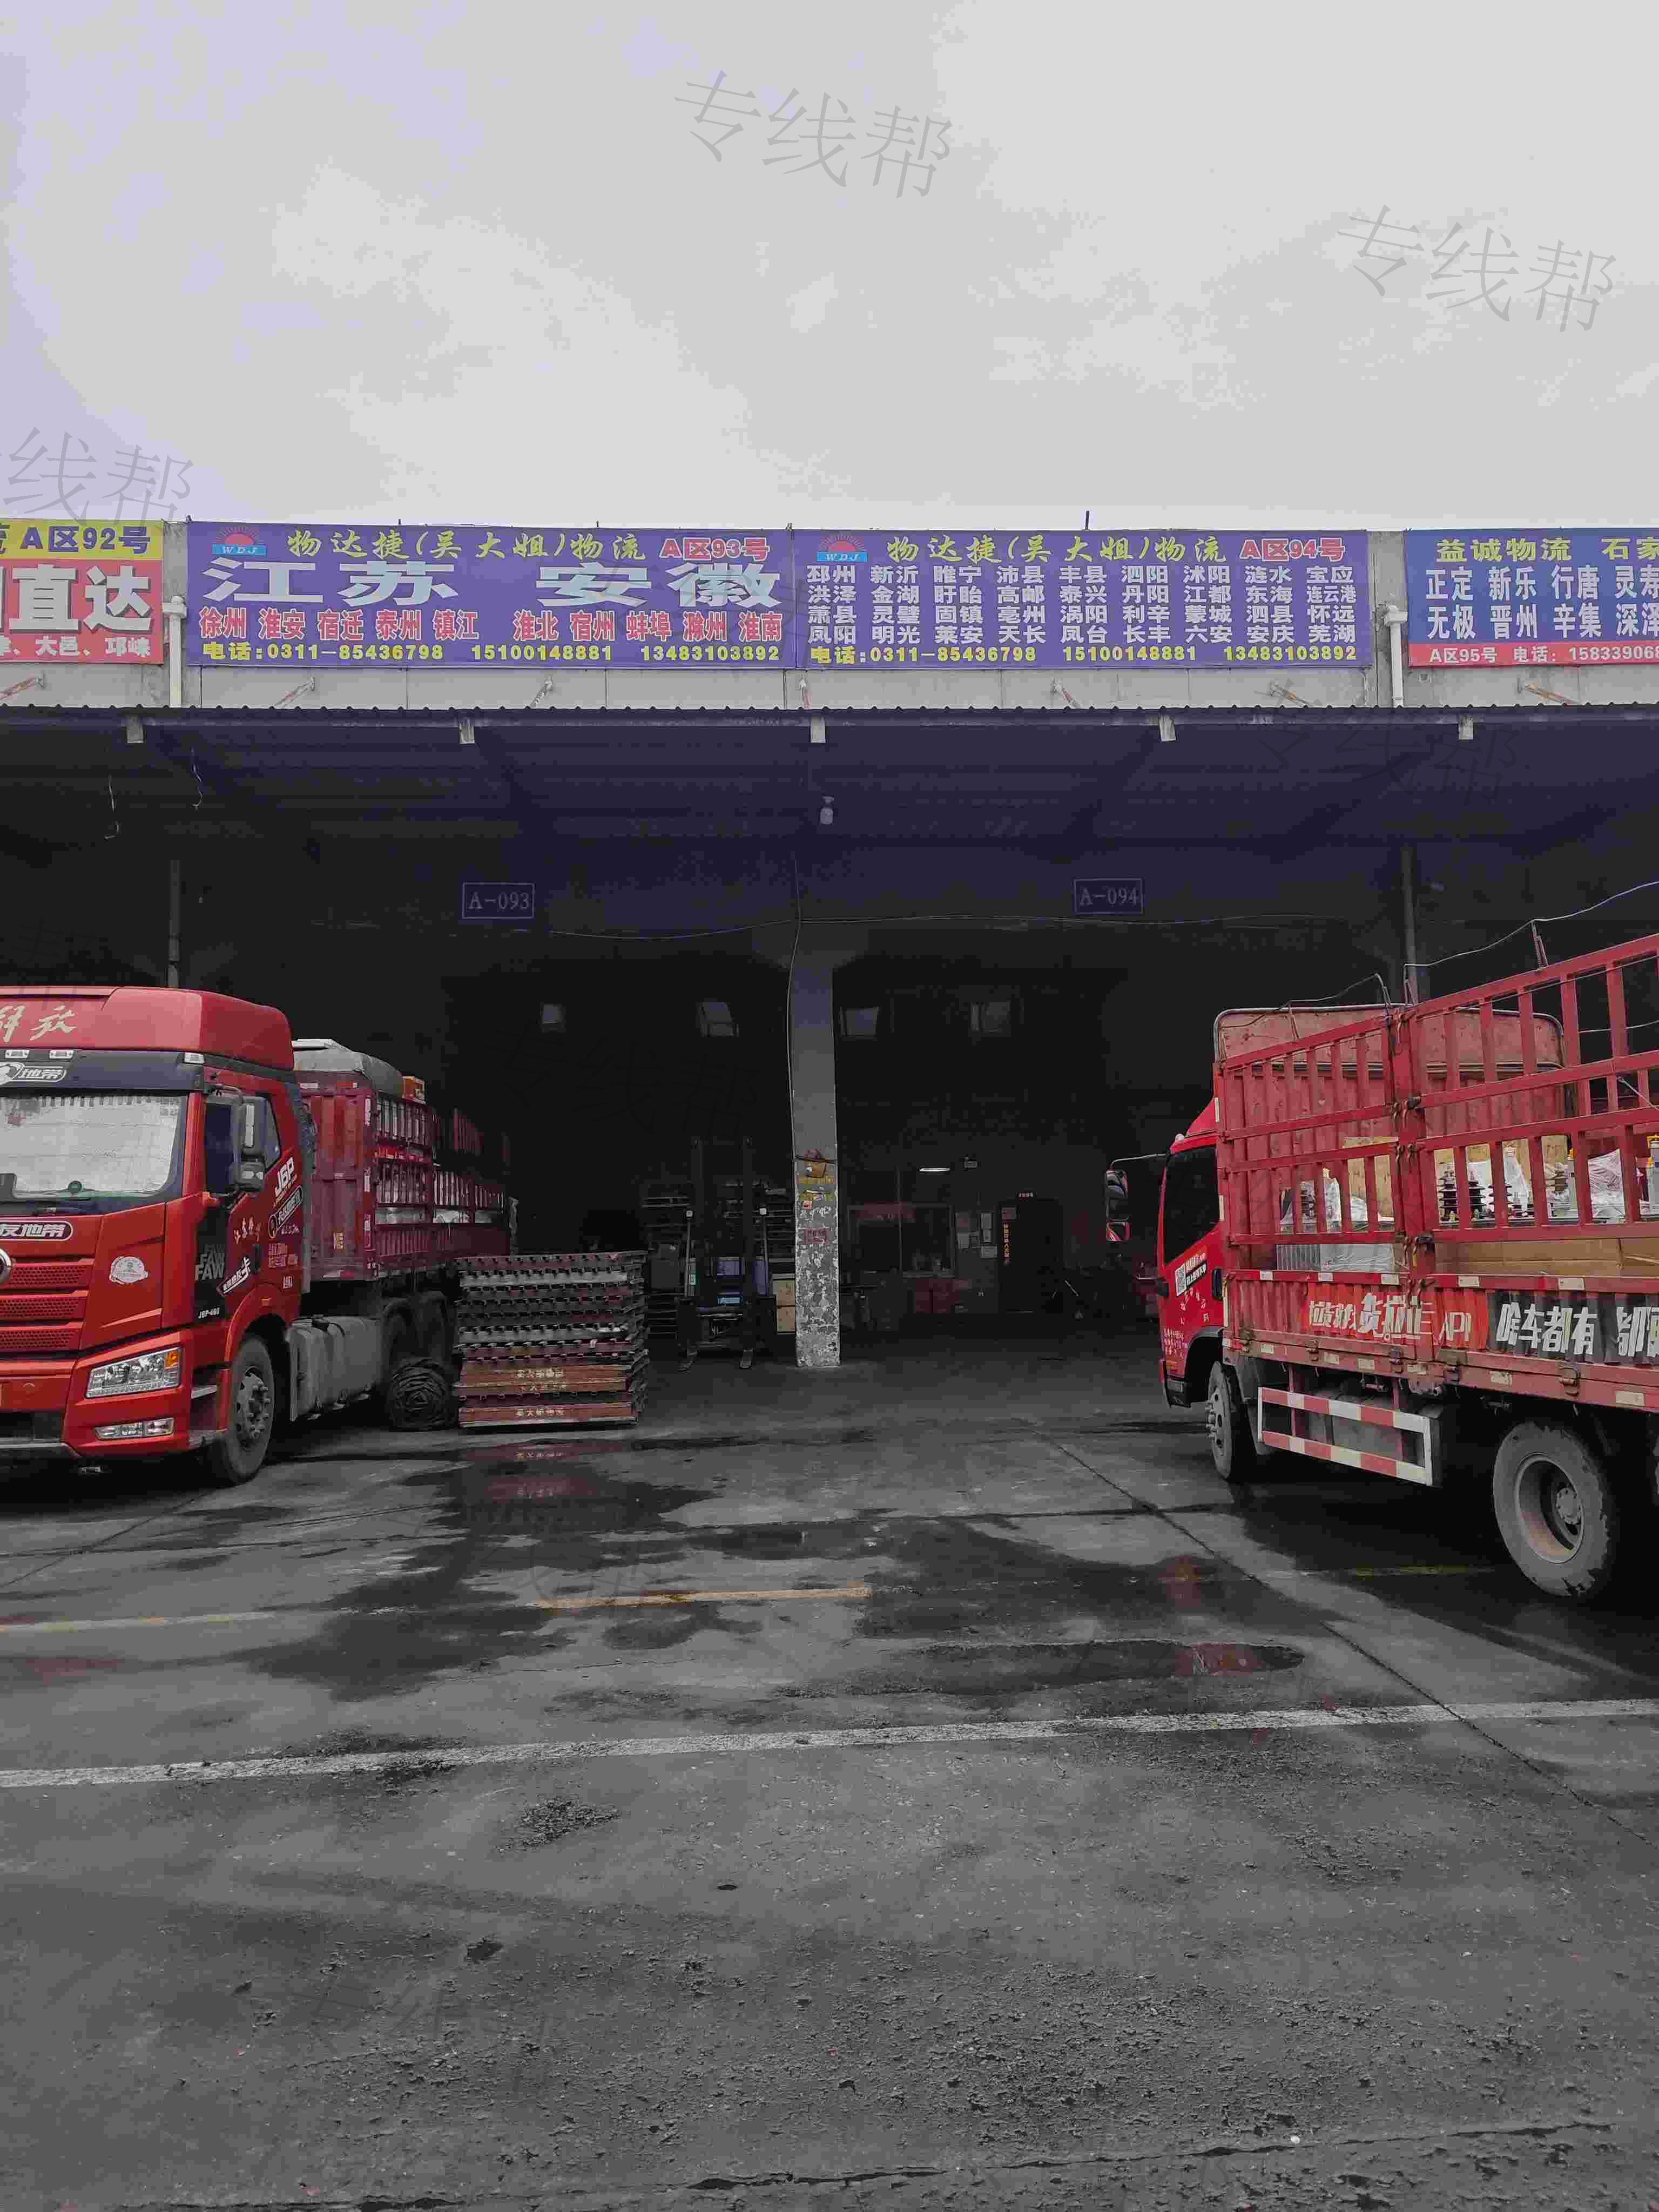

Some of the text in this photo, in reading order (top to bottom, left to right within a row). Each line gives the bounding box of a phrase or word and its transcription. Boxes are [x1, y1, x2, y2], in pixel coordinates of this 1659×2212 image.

[19, 525, 151, 554] A区92号
[659, 537, 770, 562] A区93号
[1240, 538, 1346, 562] A区94号
[1435, 537, 1573, 563] 益诚物流
[202, 557, 783, 608] 江苏 安徽
[870, 565, 919, 584] 新沂
[933, 565, 982, 584] 睢宁
[996, 565, 1046, 584] 沛县
[1059, 565, 1107, 584] 丰县
[1122, 565, 1169, 584] 泗阳
[1244, 565, 1292, 584] 涟水
[1306, 565, 1354, 584] 宝应
[1426, 567, 1473, 601] 正定
[1488, 566, 1536, 601] 新乐
[1552, 564, 1600, 600] 行唐
[9, 564, 152, 632] 直达
[807, 585, 1357, 604] 洪泽 金湖 盱眙 高邮 泰兴 丹阳 江都 东海 连云港
[199, 606, 783, 642] 徐州 淮安 宿迁 泰州 镇江 淮北 宿州 蚌埠 滁州 淮南
[808, 605, 857, 624] 萧县
[935, 605, 983, 624] 固镇
[1060, 605, 1108, 624] 涡阳
[1123, 605, 1171, 624] 利辛
[1185, 605, 1232, 624] 蒙城
[1246, 605, 1294, 624] 泗县
[1307, 605, 1355, 624] 怀远
[1427, 604, 1477, 639] 无极
[1490, 604, 1537, 639] 晋州
[1554, 603, 1602, 638] 辛集
[808, 625, 857, 644] 凤阳
[872, 625, 921, 644] 明光
[998, 625, 1046, 644] 天长
[1061, 625, 1108, 644] 凤台
[1123, 625, 1171, 644] 长丰
[1185, 625, 1232, 644] 六安
[1247, 625, 1294, 644] 安庆
[1308, 625, 1356, 644] 芜湖
[471, 644, 612, 661] 15100148881
[641, 645, 779, 661] 13483103892
[1063, 646, 1196, 661] 15100148881
[1225, 646, 1357, 661] 13483103892
[1429, 647, 1498, 664] A区95号
[467, 891, 529, 911] A-093
[1080, 887, 1138, 907] A-094
